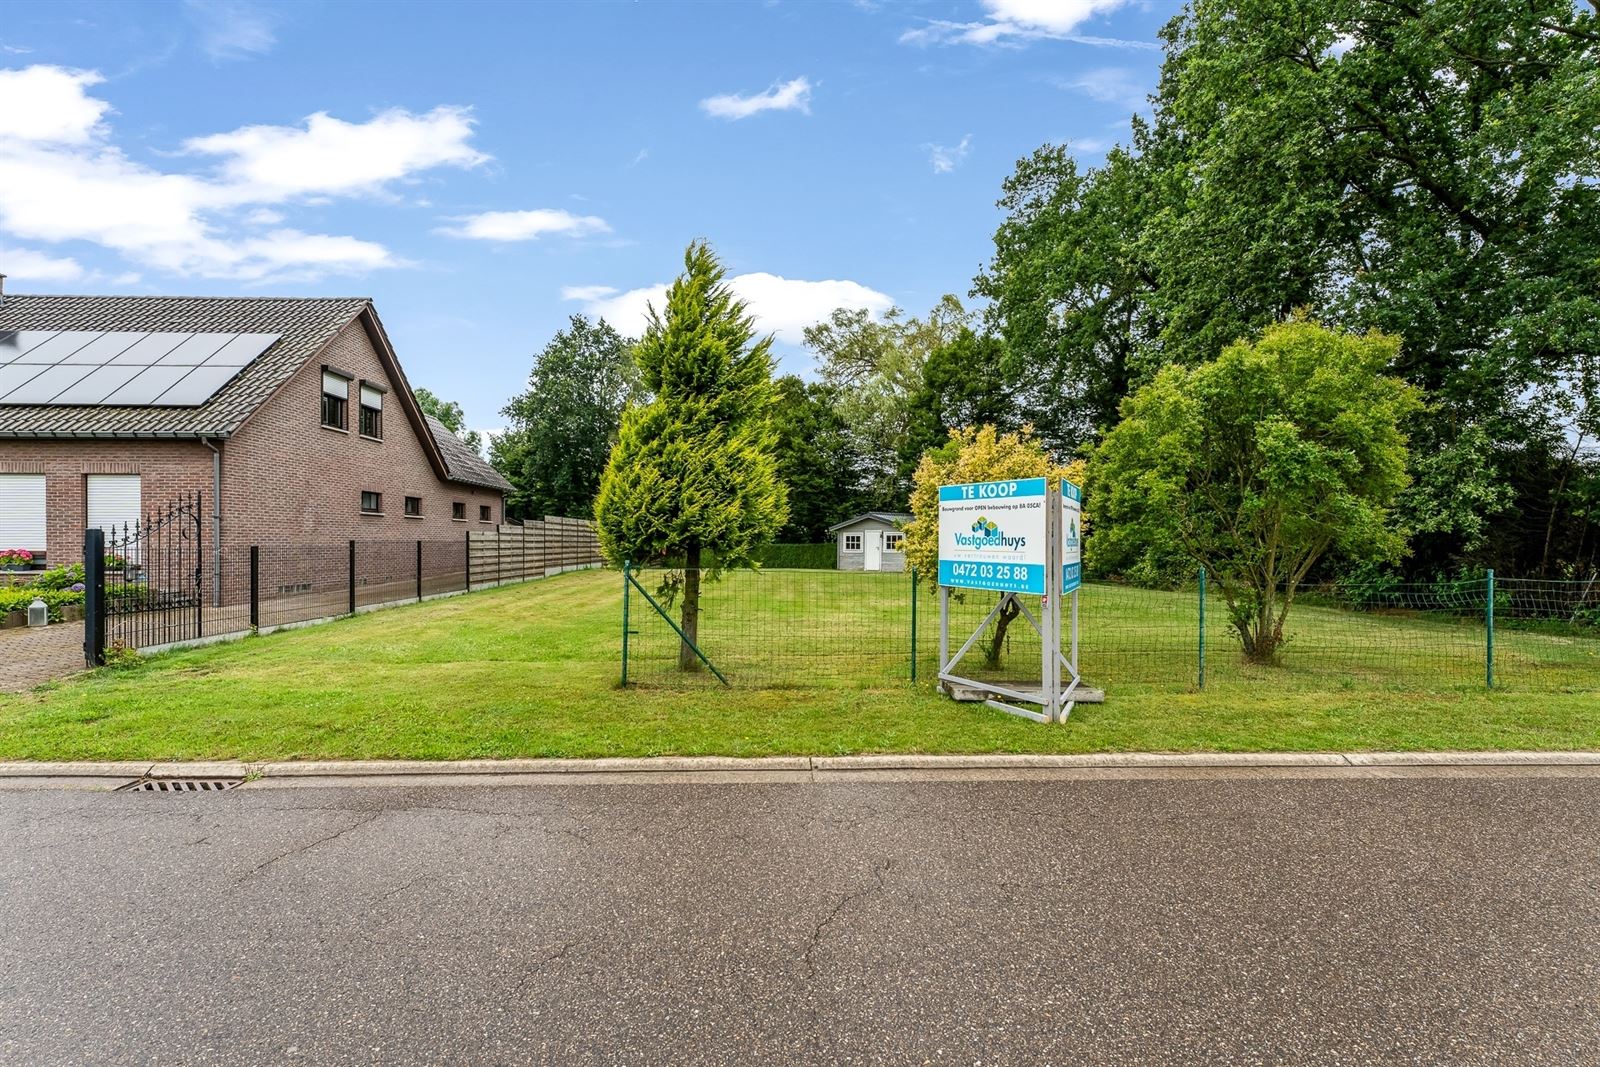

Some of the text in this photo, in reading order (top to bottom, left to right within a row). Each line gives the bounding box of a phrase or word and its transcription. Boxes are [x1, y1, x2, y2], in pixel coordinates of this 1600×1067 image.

[961, 482, 1018, 499] TE KOOP
[954, 531, 1026, 550] Vastgoedhuys
[952, 564, 1028, 580] 0472 03 25 88
